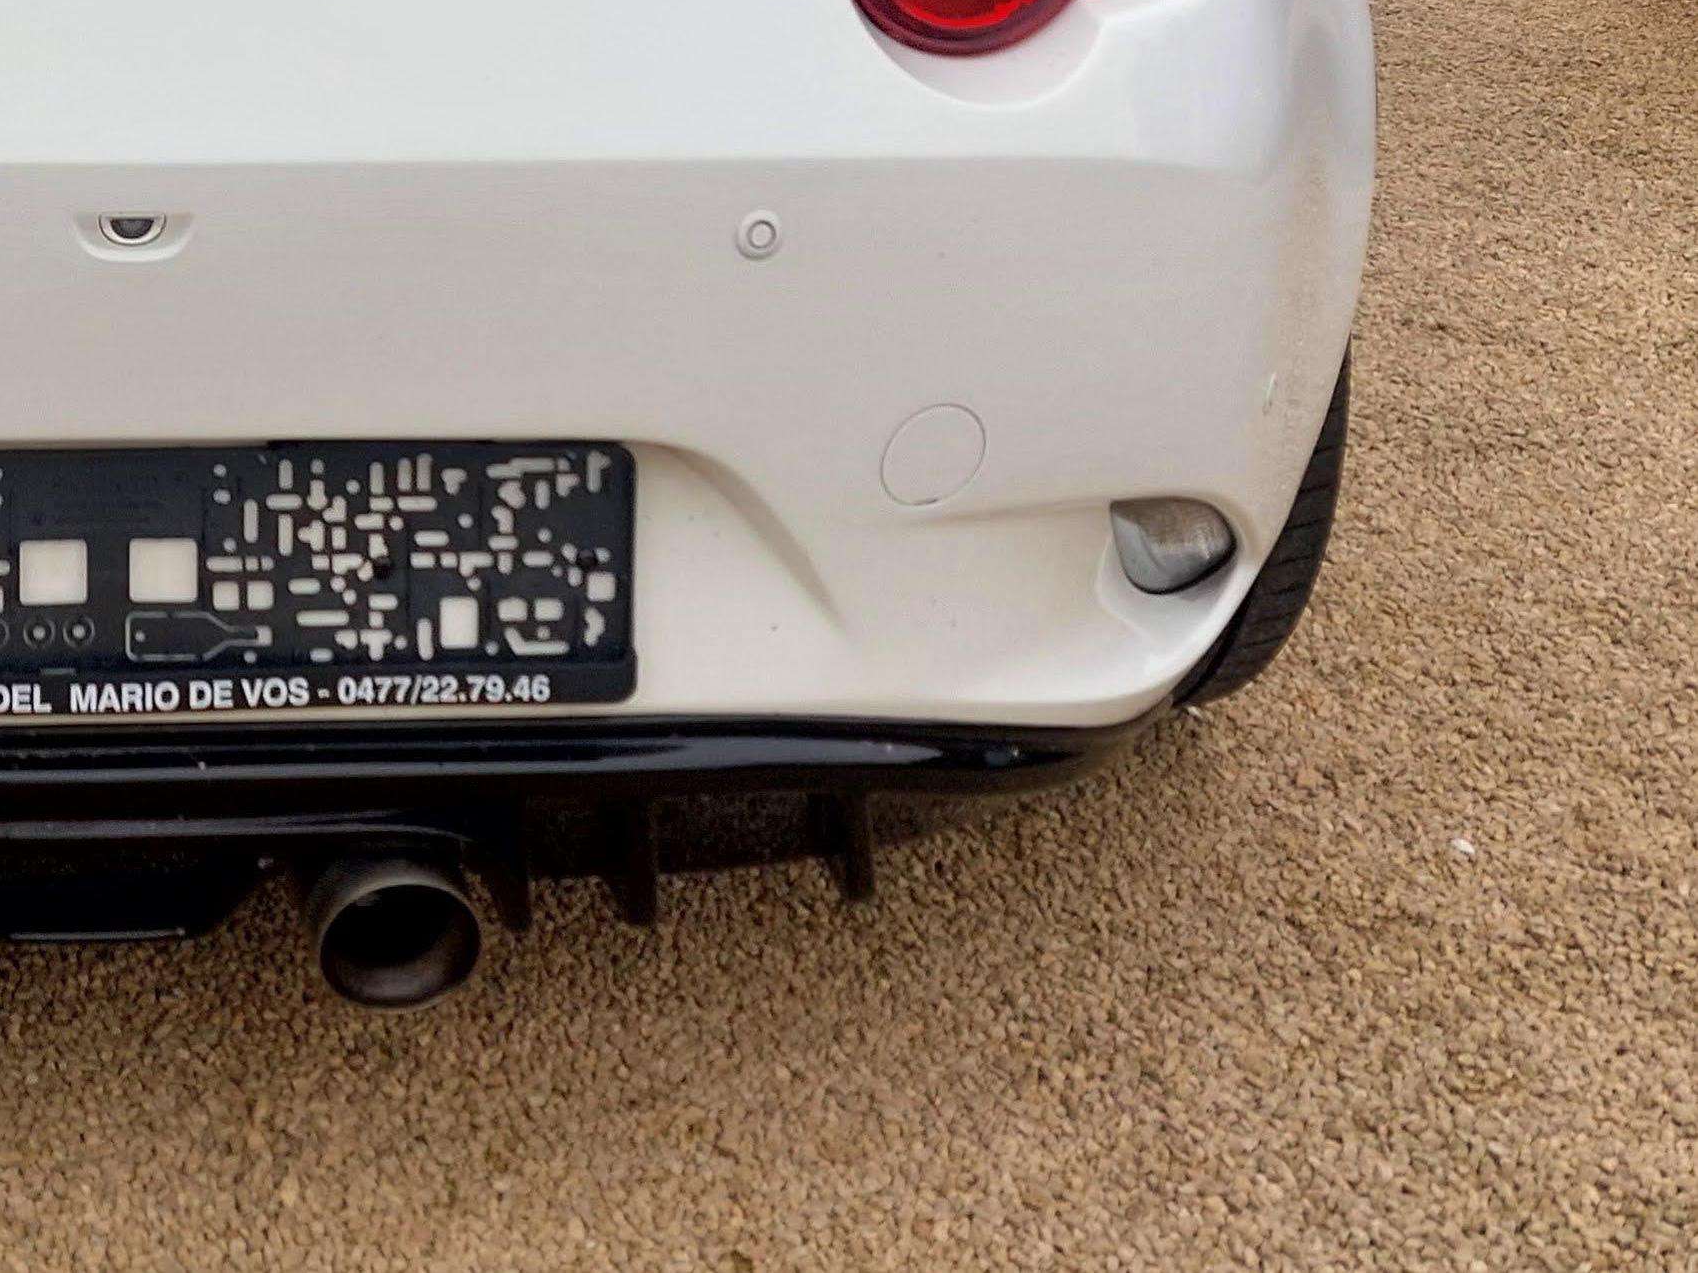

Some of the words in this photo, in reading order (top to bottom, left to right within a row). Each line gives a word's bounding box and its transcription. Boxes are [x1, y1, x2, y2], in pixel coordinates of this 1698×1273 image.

[69, 680, 180, 714] MARIO
[189, 679, 234, 710] DE
[240, 676, 310, 708] VOS
[336, 674, 551, 706] 0477/22.79.46
